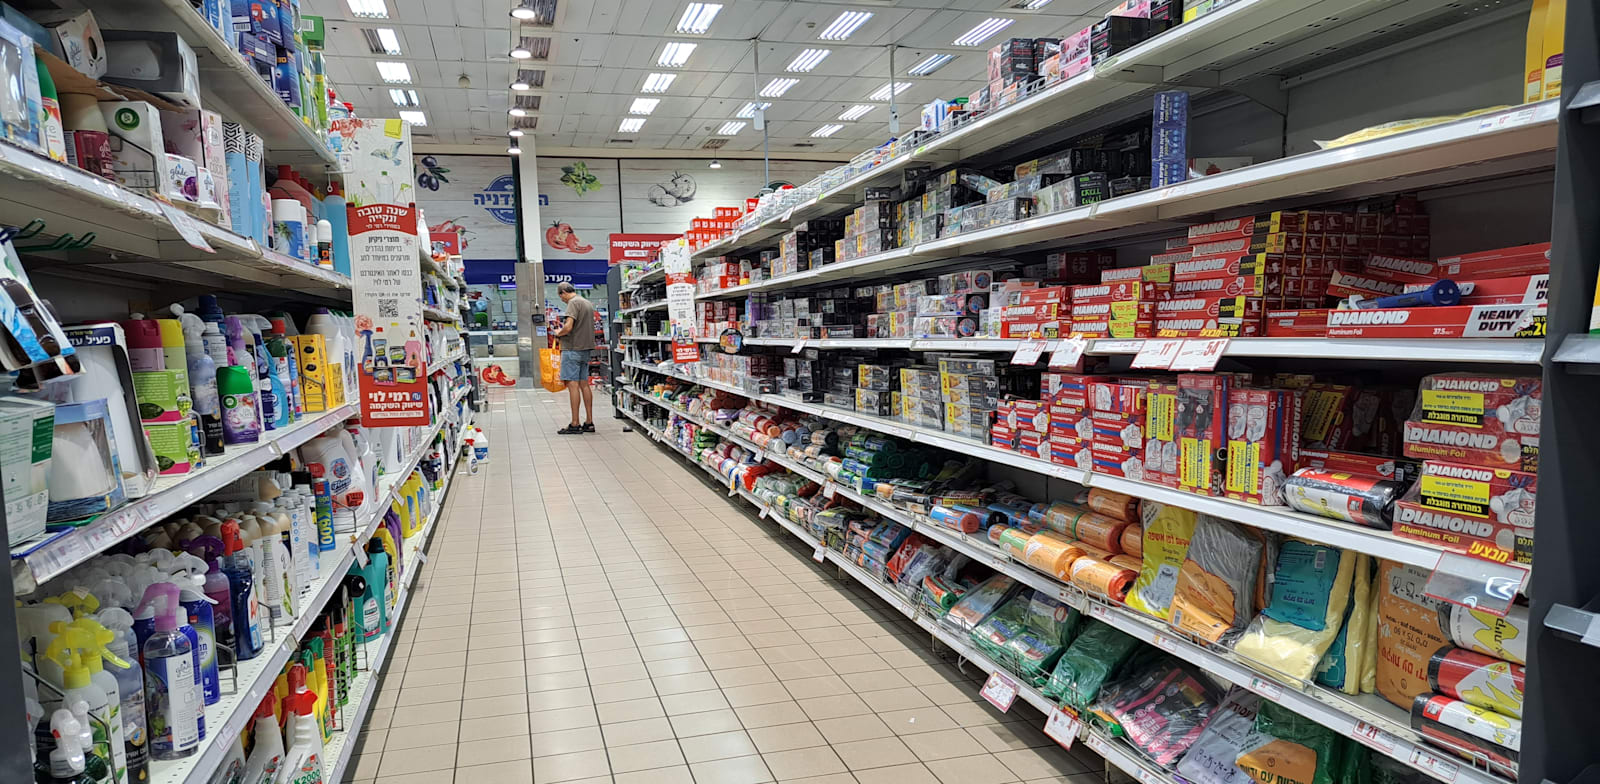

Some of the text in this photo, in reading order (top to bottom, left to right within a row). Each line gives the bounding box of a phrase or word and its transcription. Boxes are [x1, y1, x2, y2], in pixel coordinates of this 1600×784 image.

[473, 193, 549, 206] הדניה
[357, 206, 408, 217] שנה טובה
[368, 215, 397, 224] ונקייה
[1191, 220, 1240, 236] DIAMOND
[612, 240, 660, 249] שיווק השקמה
[1194, 240, 1245, 256] DIAMOND
[1177, 258, 1226, 274] DIAMOND
[1370, 255, 1434, 275] DIAMOND
[1103, 269, 1140, 281] DIAMOND
[1175, 279, 1224, 292] DIAMOND
[1074, 286, 1110, 298] DIAMOND
[1007, 306, 1036, 315] DIAMOND
[1073, 304, 1111, 315] DIAMOND
[1157, 299, 1206, 311] DIAMOND
[1331, 310, 1410, 325] DIAMOND
[1478, 310, 1525, 320] HEAVY
[1009, 323, 1039, 332] DIAMOND
[1072, 322, 1108, 332] DIAMOND
[1157, 319, 1205, 330] DIAMOND
[1478, 321, 1516, 331] DUTY
[85, 335, 111, 345] פעיל
[1437, 379, 1499, 392] DIAMOND
[368, 390, 411, 402] רמי לוי
[369, 401, 423, 411] שיווק השקמה
[1292, 397, 1301, 461] DIAMOND
[1410, 427, 1498, 450] DIAMOND
[1409, 444, 1466, 457] Aluminum Foil
[1428, 465, 1493, 482] DIAMOND
[1400, 508, 1494, 538] DIAMOND
[1400, 525, 1460, 544] Aluminum Foil
[1381, 648, 1401, 668] שקיות
[1402, 660, 1414, 675] עם
